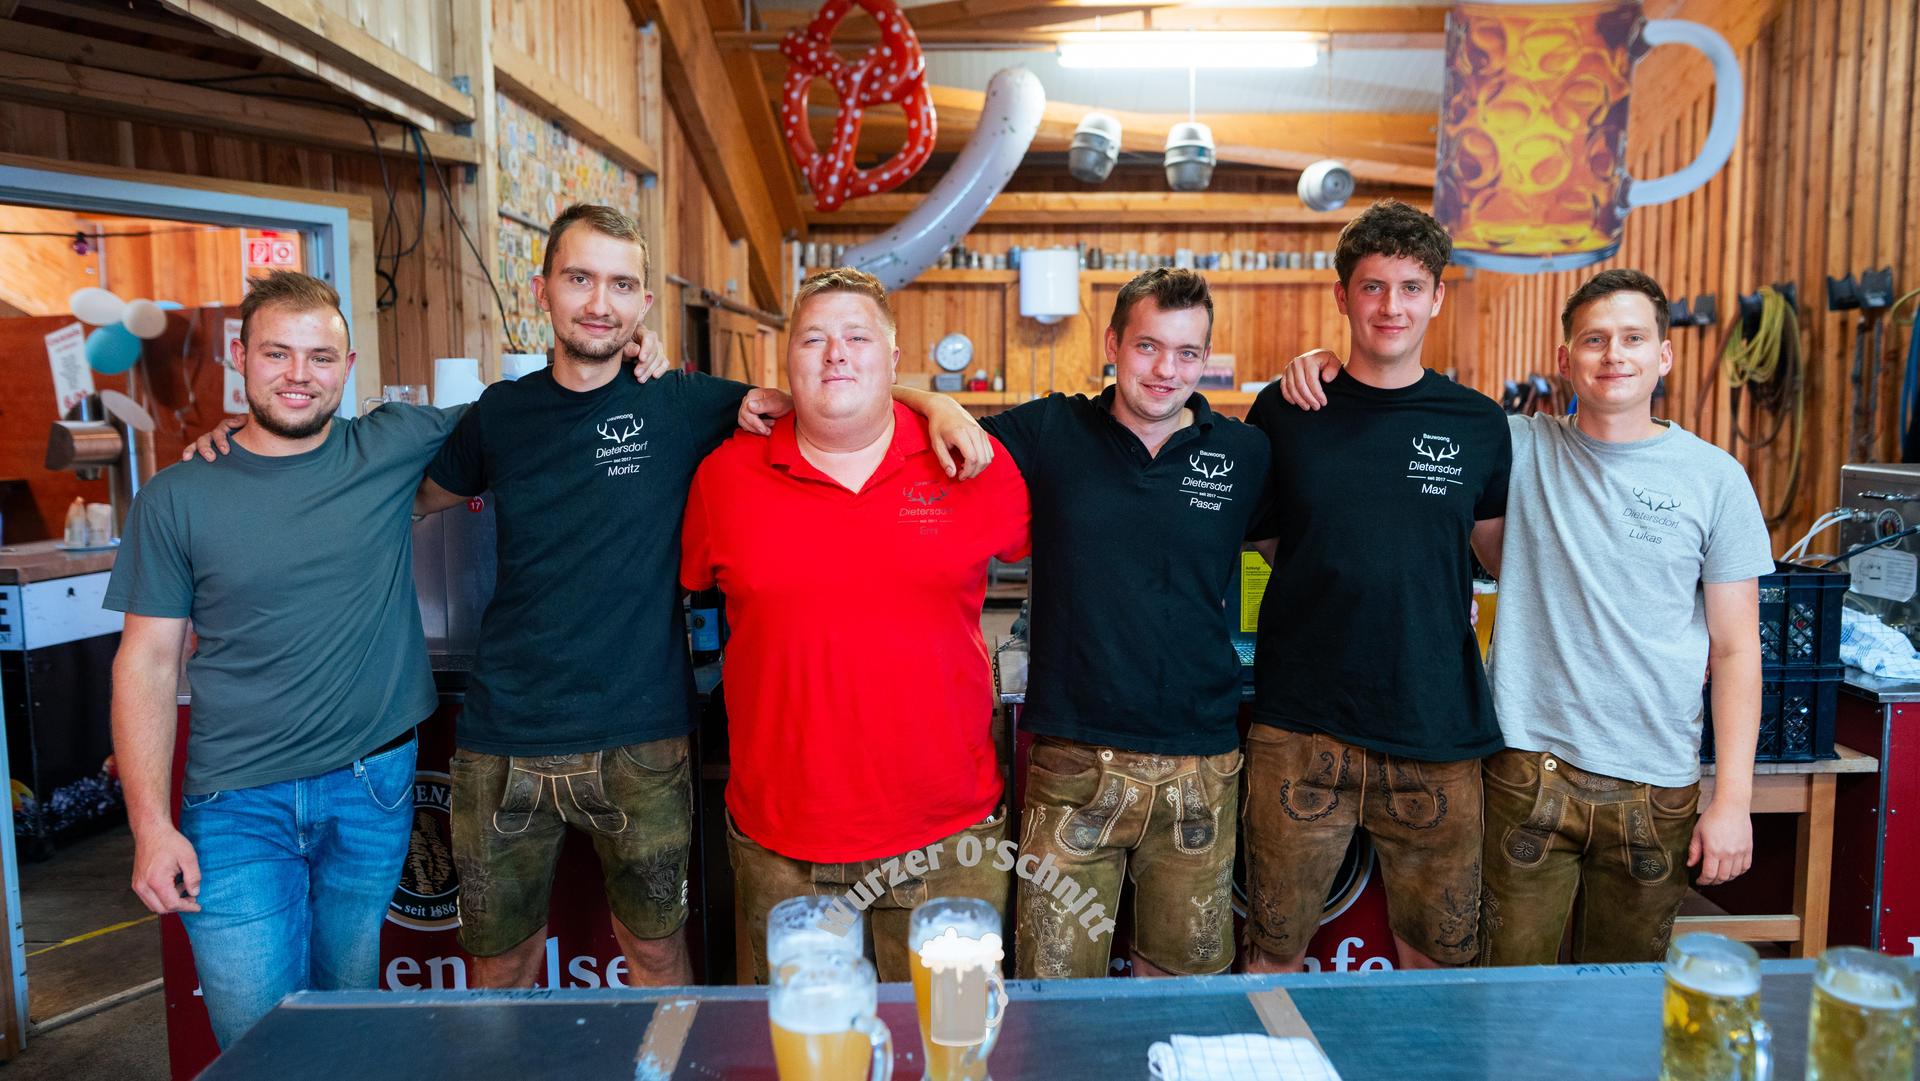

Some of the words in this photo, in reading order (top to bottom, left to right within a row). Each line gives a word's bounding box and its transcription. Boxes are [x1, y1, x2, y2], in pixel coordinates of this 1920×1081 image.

[595, 440, 649, 459] Dietersdorf
[607, 463, 640, 477] Moritz
[1408, 460, 1463, 476] Dietersdorf
[1181, 476, 1234, 493] Dietersdorf
[1421, 483, 1448, 496] Maxi
[471, 502, 481, 510] 17
[1189, 497, 1222, 511] Pascal
[1622, 507, 1680, 529] Dietersdorf
[1628, 528, 1663, 545] Lukas
[404, 904, 426, 917] seit
[430, 901, 456, 918] 1886
